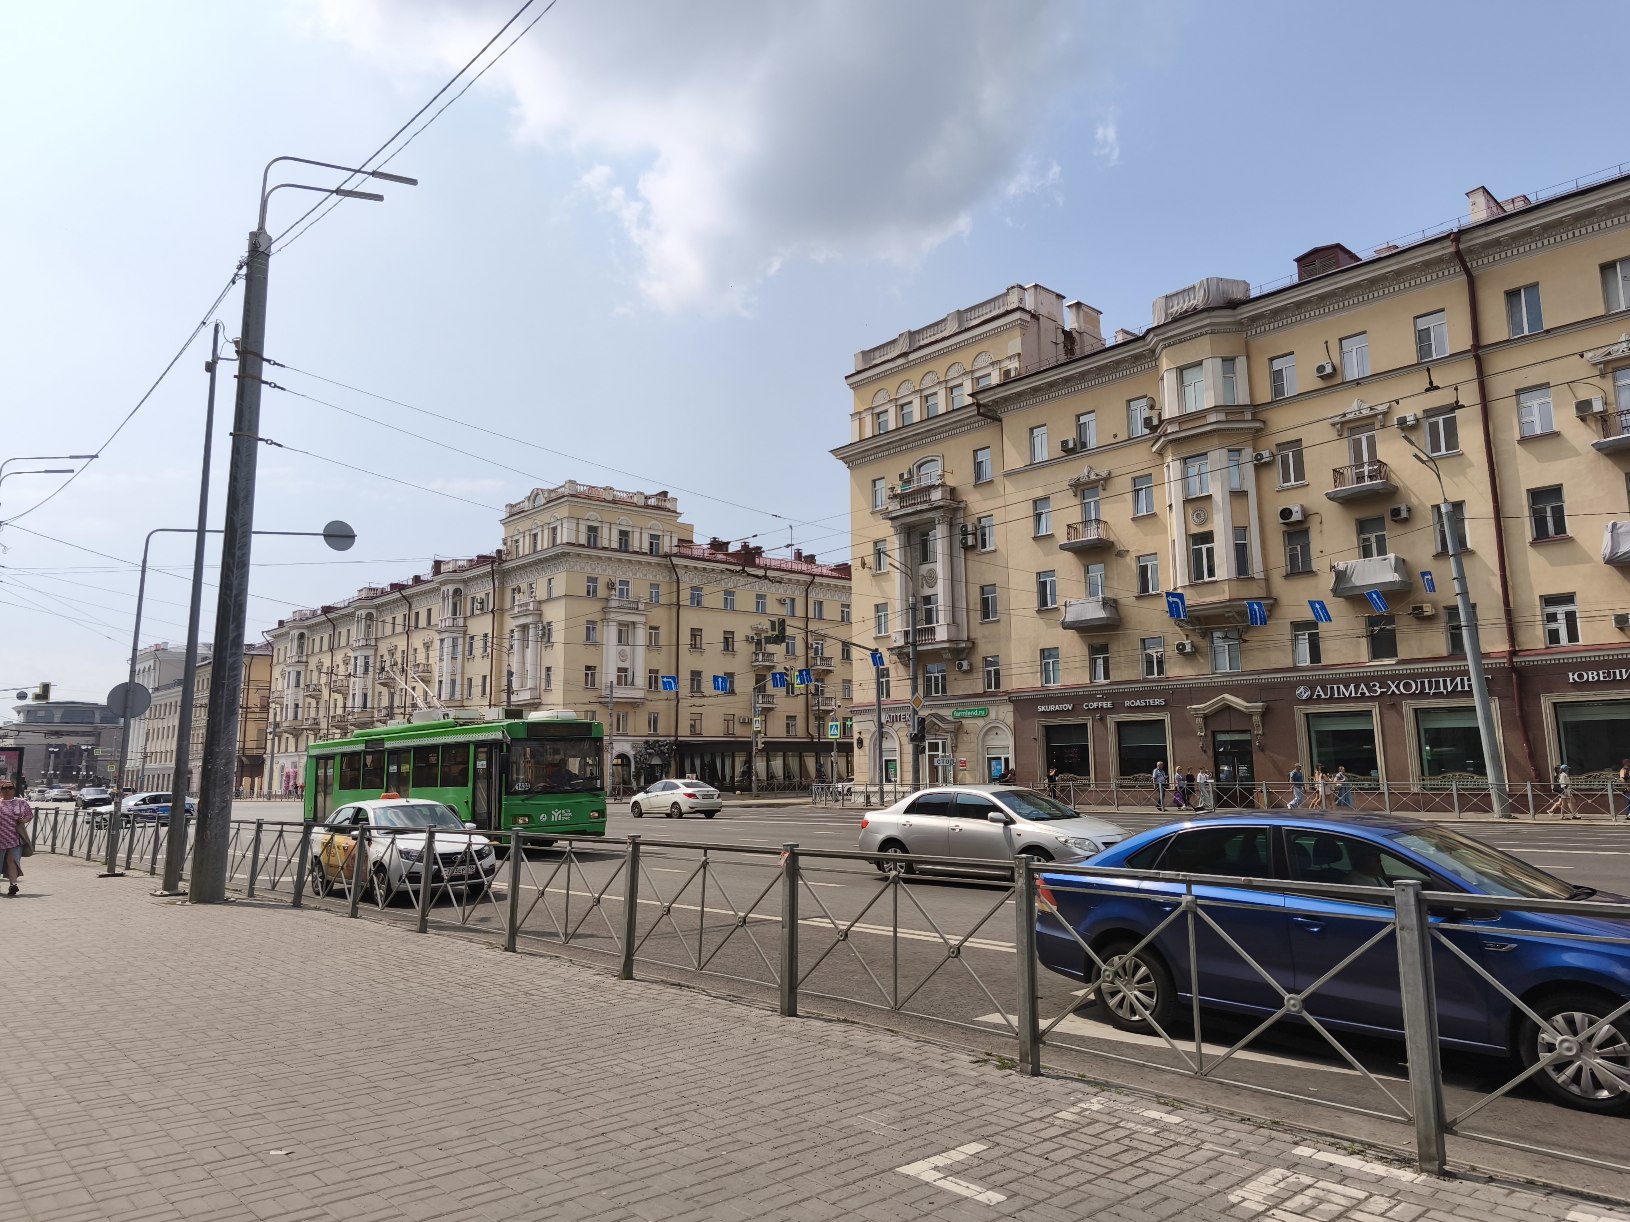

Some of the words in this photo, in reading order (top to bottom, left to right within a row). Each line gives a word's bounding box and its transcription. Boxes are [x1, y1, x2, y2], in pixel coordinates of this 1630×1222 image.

[1312, 675, 1491, 699] АЛМАЗ-ХОЛДИН
[1037, 704, 1073, 712] SKURATOV
[1083, 701, 1113, 709] COFFEE
[1125, 699, 1166, 707] ROASTERS
